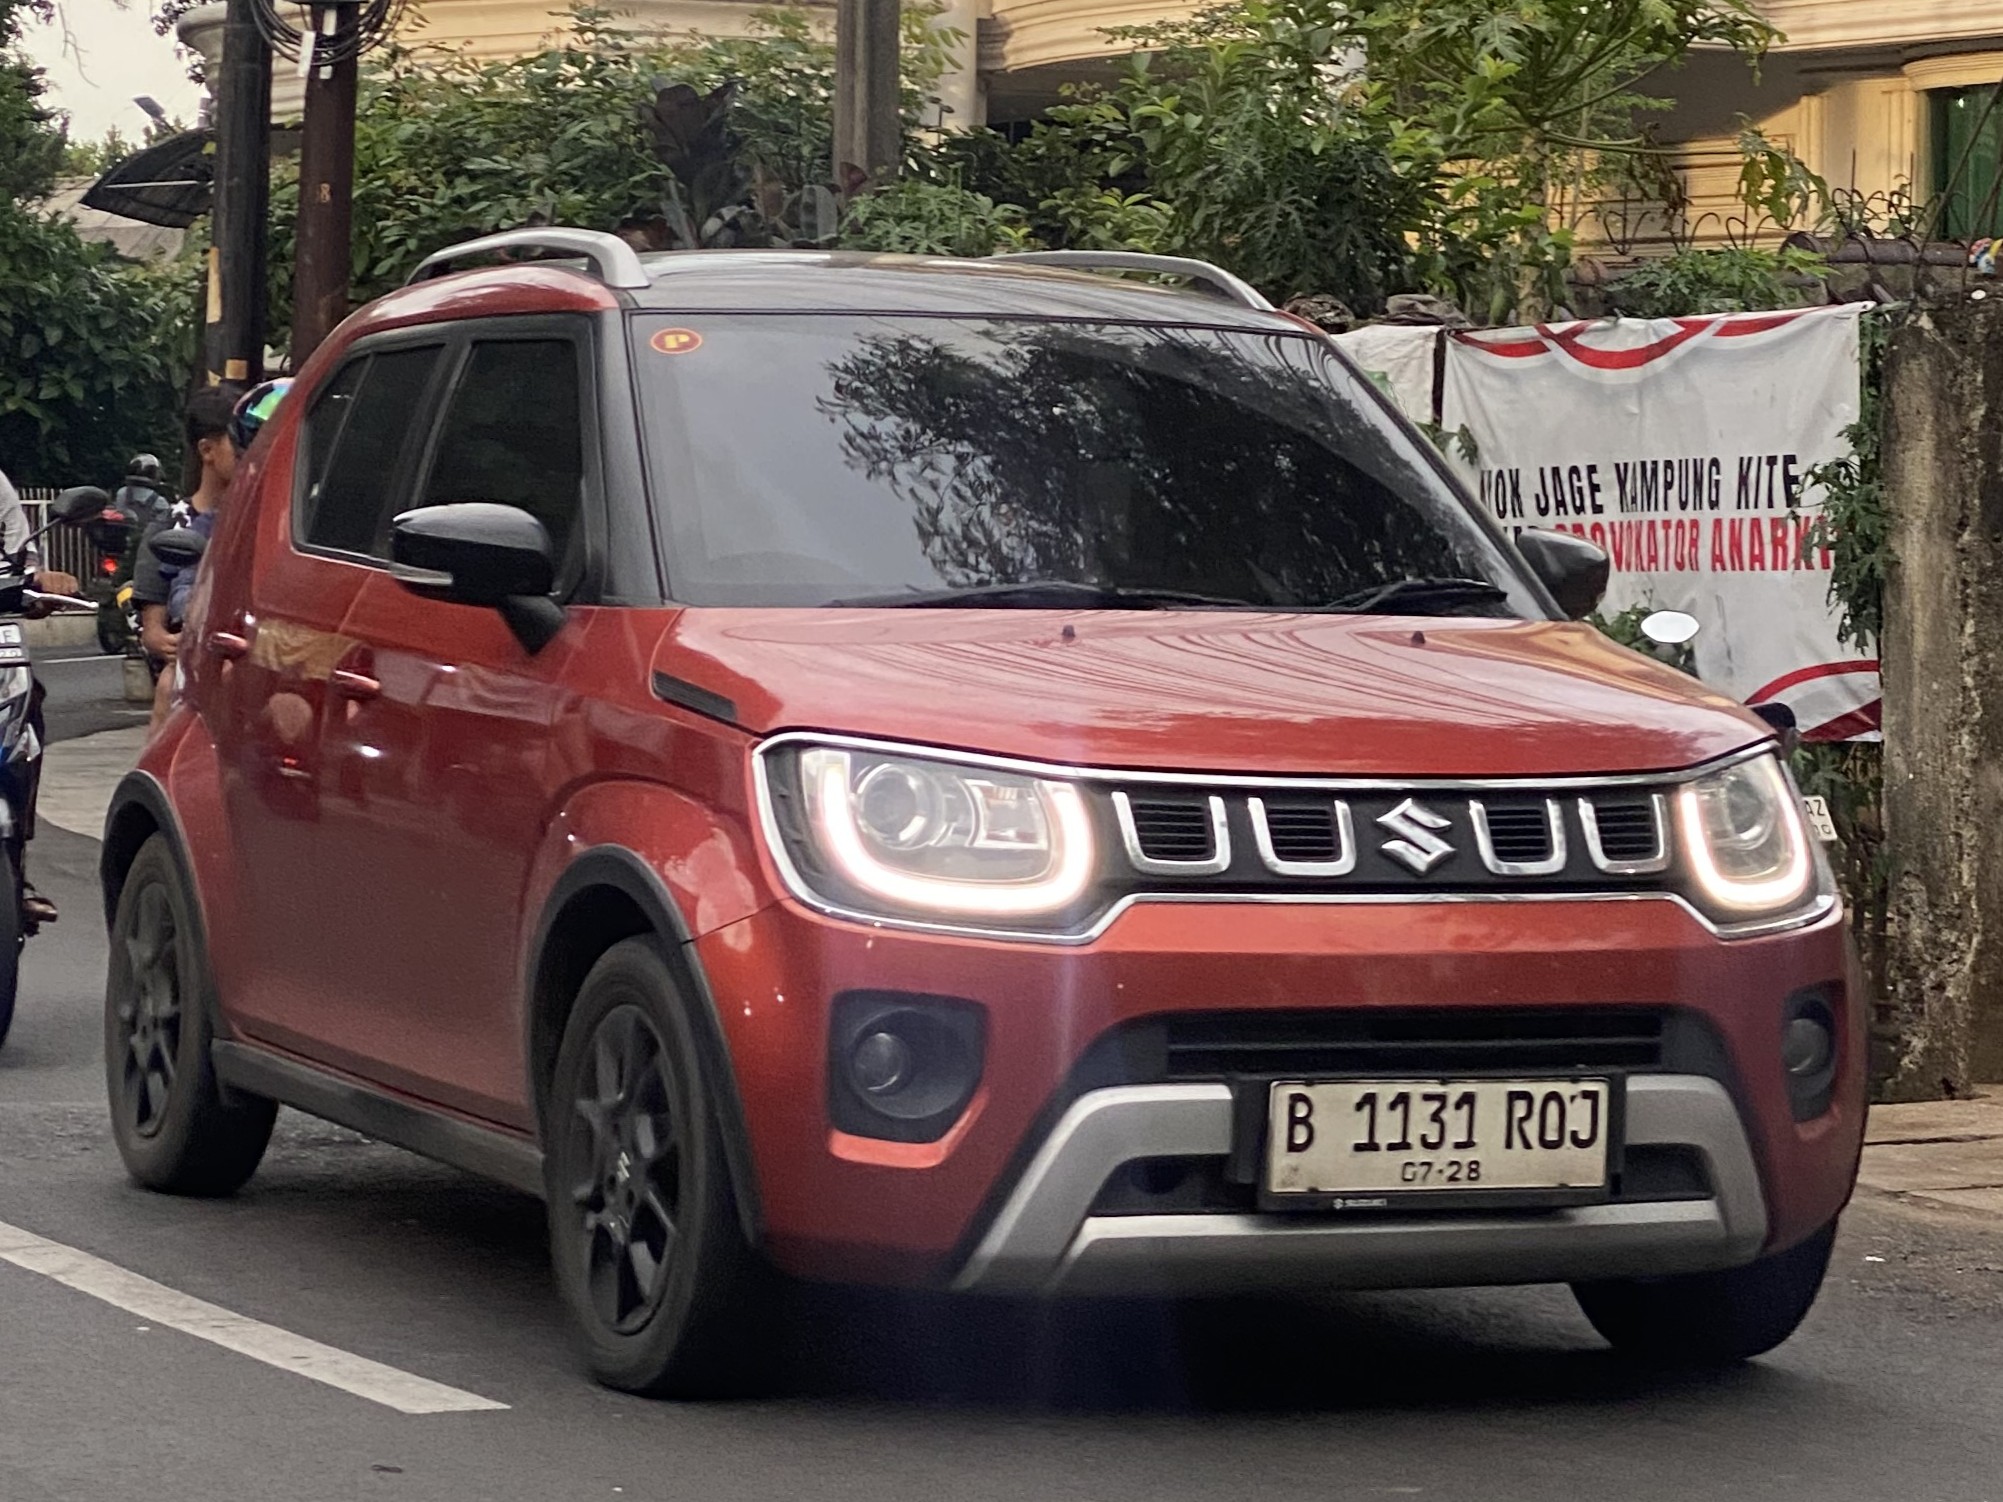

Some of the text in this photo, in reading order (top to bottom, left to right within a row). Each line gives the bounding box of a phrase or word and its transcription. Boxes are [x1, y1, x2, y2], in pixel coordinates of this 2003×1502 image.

[1535, 464, 1604, 517] JAGE
[1736, 454, 1799, 510] KITE
[1287, 1090, 1600, 1152] B 1131 ROJ
